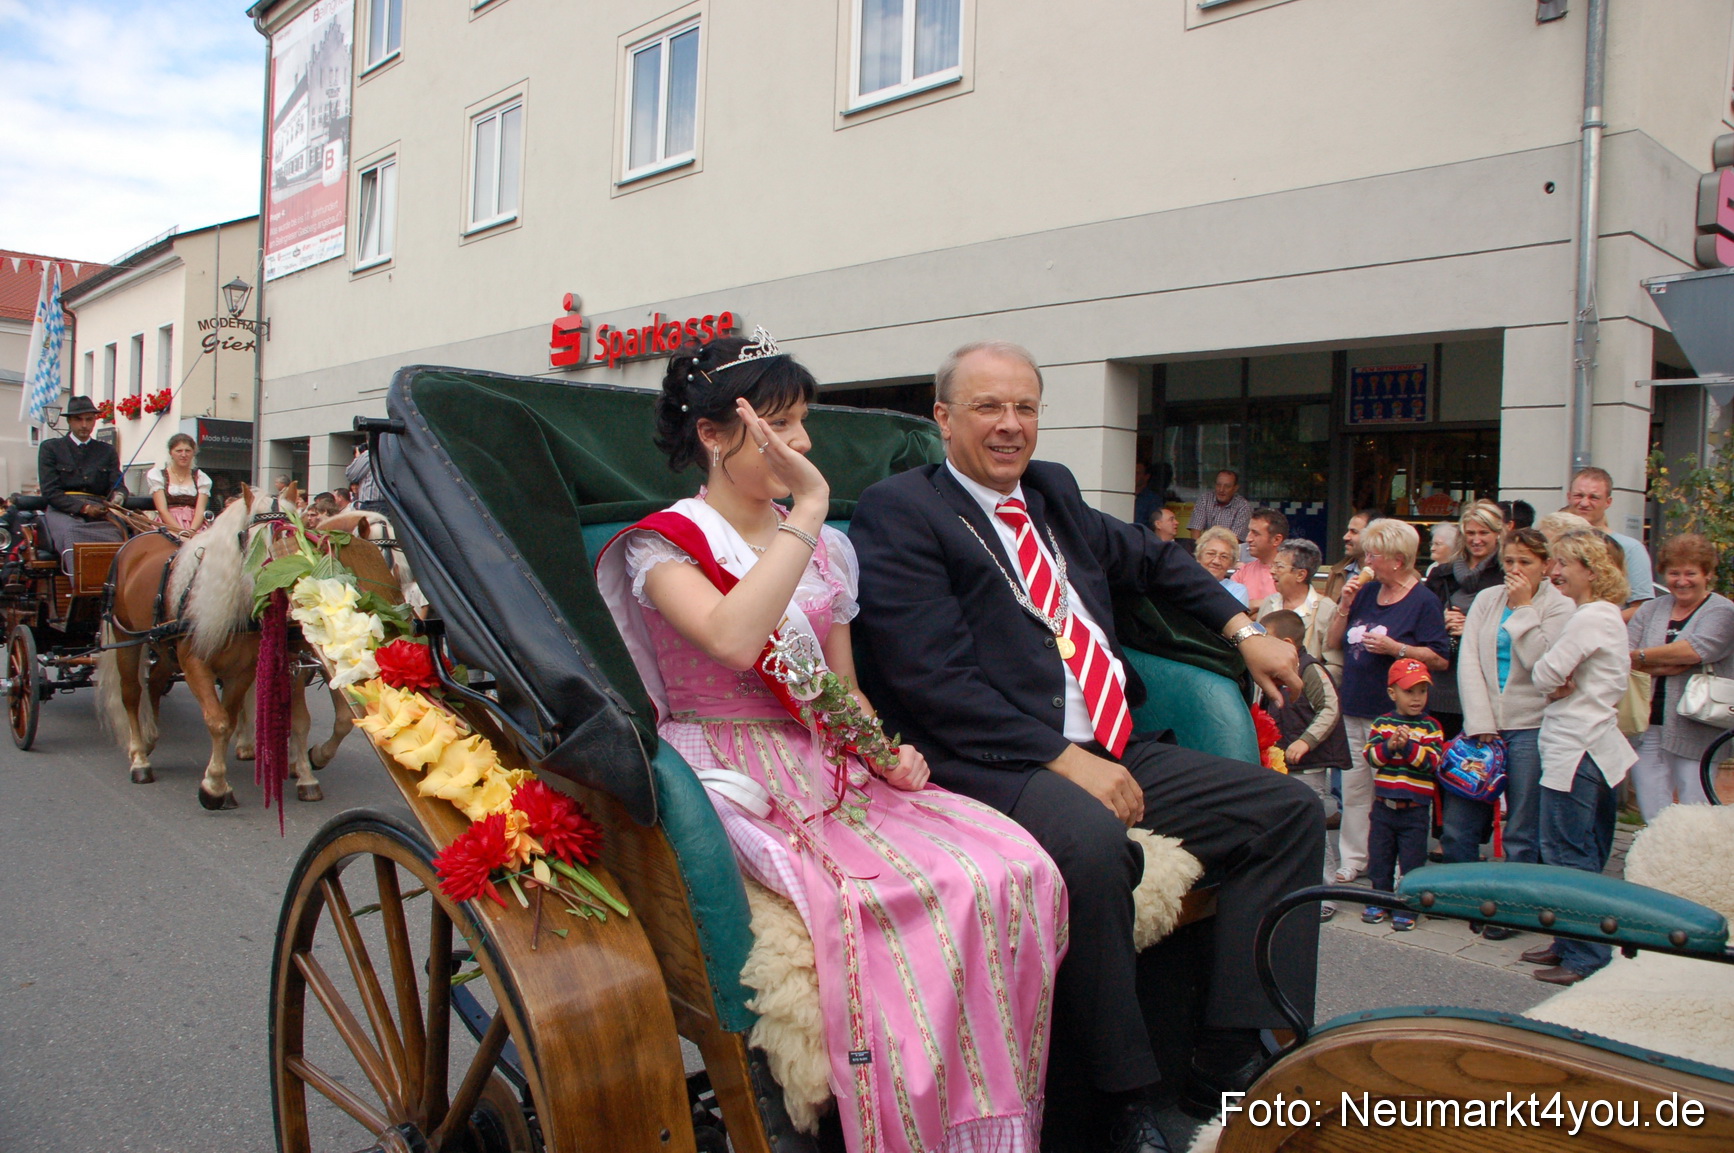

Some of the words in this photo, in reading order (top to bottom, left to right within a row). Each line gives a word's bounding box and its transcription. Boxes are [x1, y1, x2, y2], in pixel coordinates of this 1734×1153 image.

[325, 148, 334, 171] B
[197, 317, 257, 332] MODEHA
[594, 311, 735, 369] Sparkasse
[202, 434, 221, 442] Mode
[221, 434, 230, 443] für
[231, 436, 254, 444] Männe
